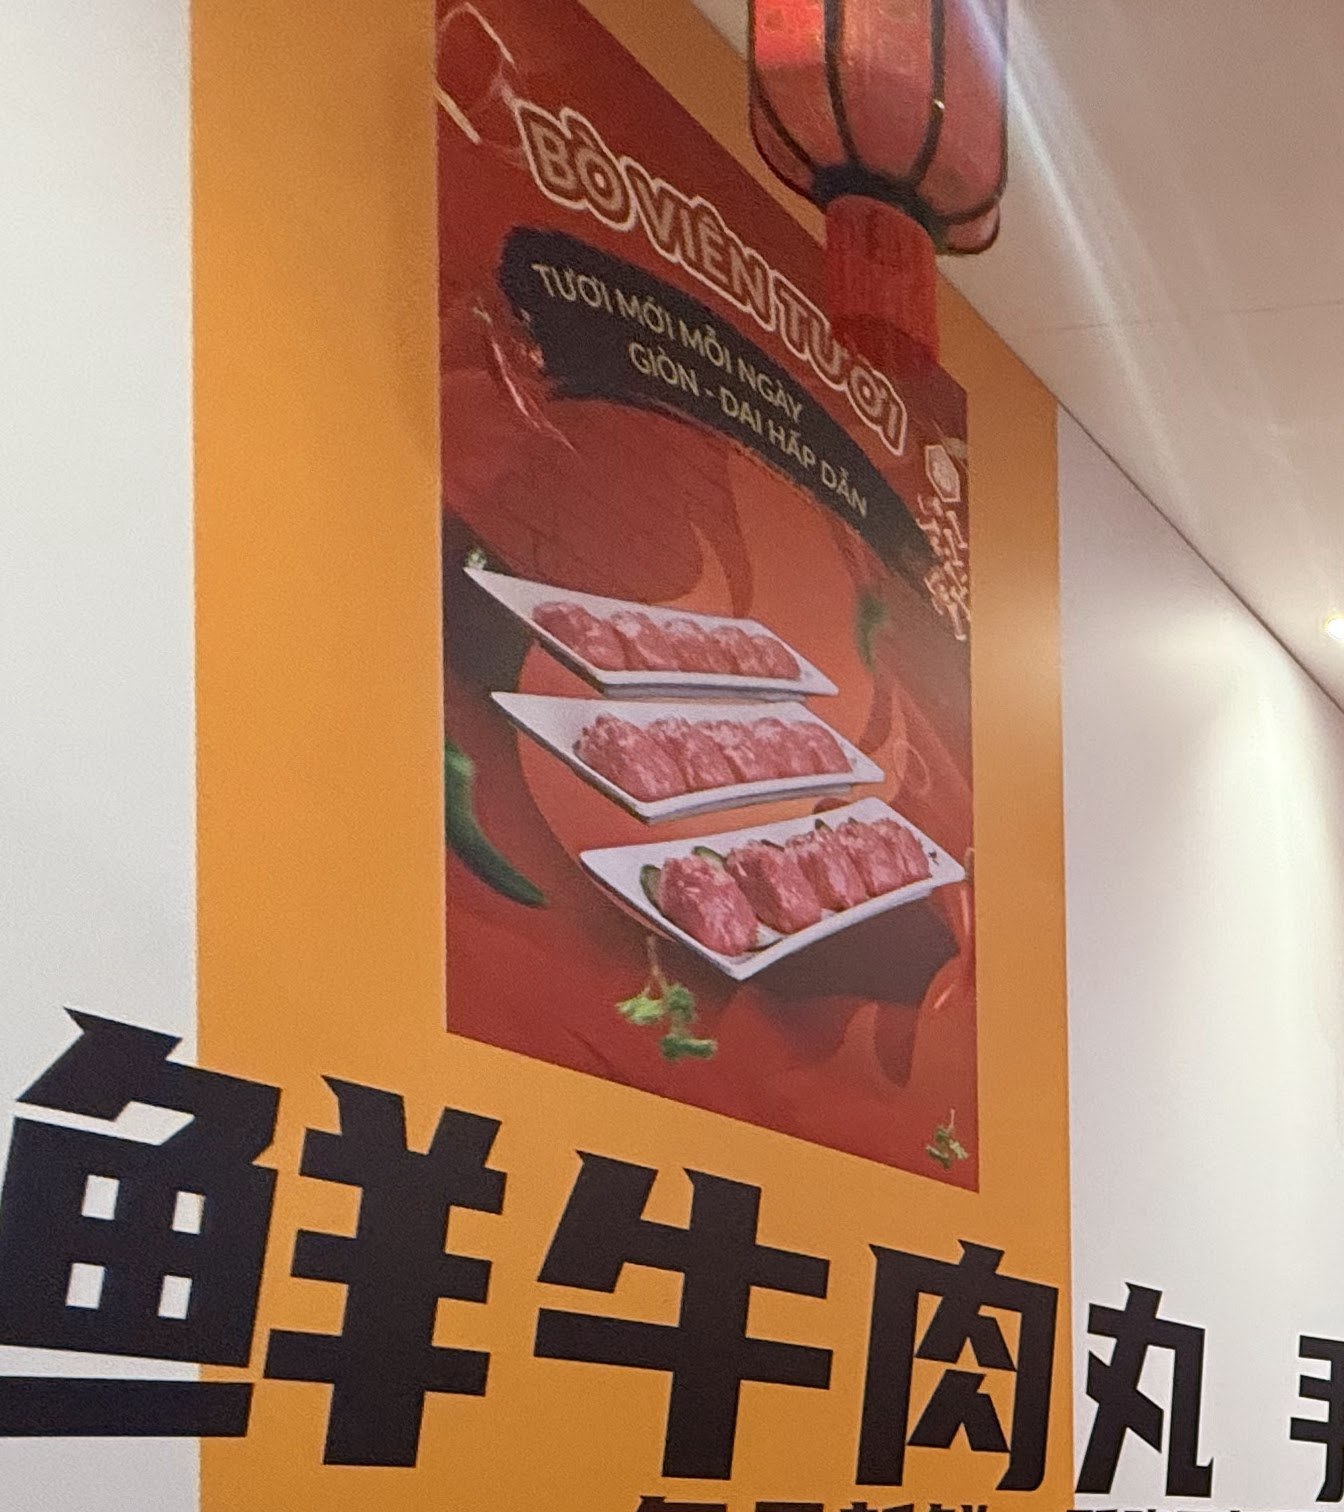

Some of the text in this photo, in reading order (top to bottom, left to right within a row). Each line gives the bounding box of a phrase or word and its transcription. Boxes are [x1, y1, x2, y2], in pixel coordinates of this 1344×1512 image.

[518, 103, 635, 230] BÒ
[624, 158, 774, 331] VIÊN
[532, 262, 613, 315] TƯƠI
[0, 1006, 1214, 1497] 鲜牛肉丸
